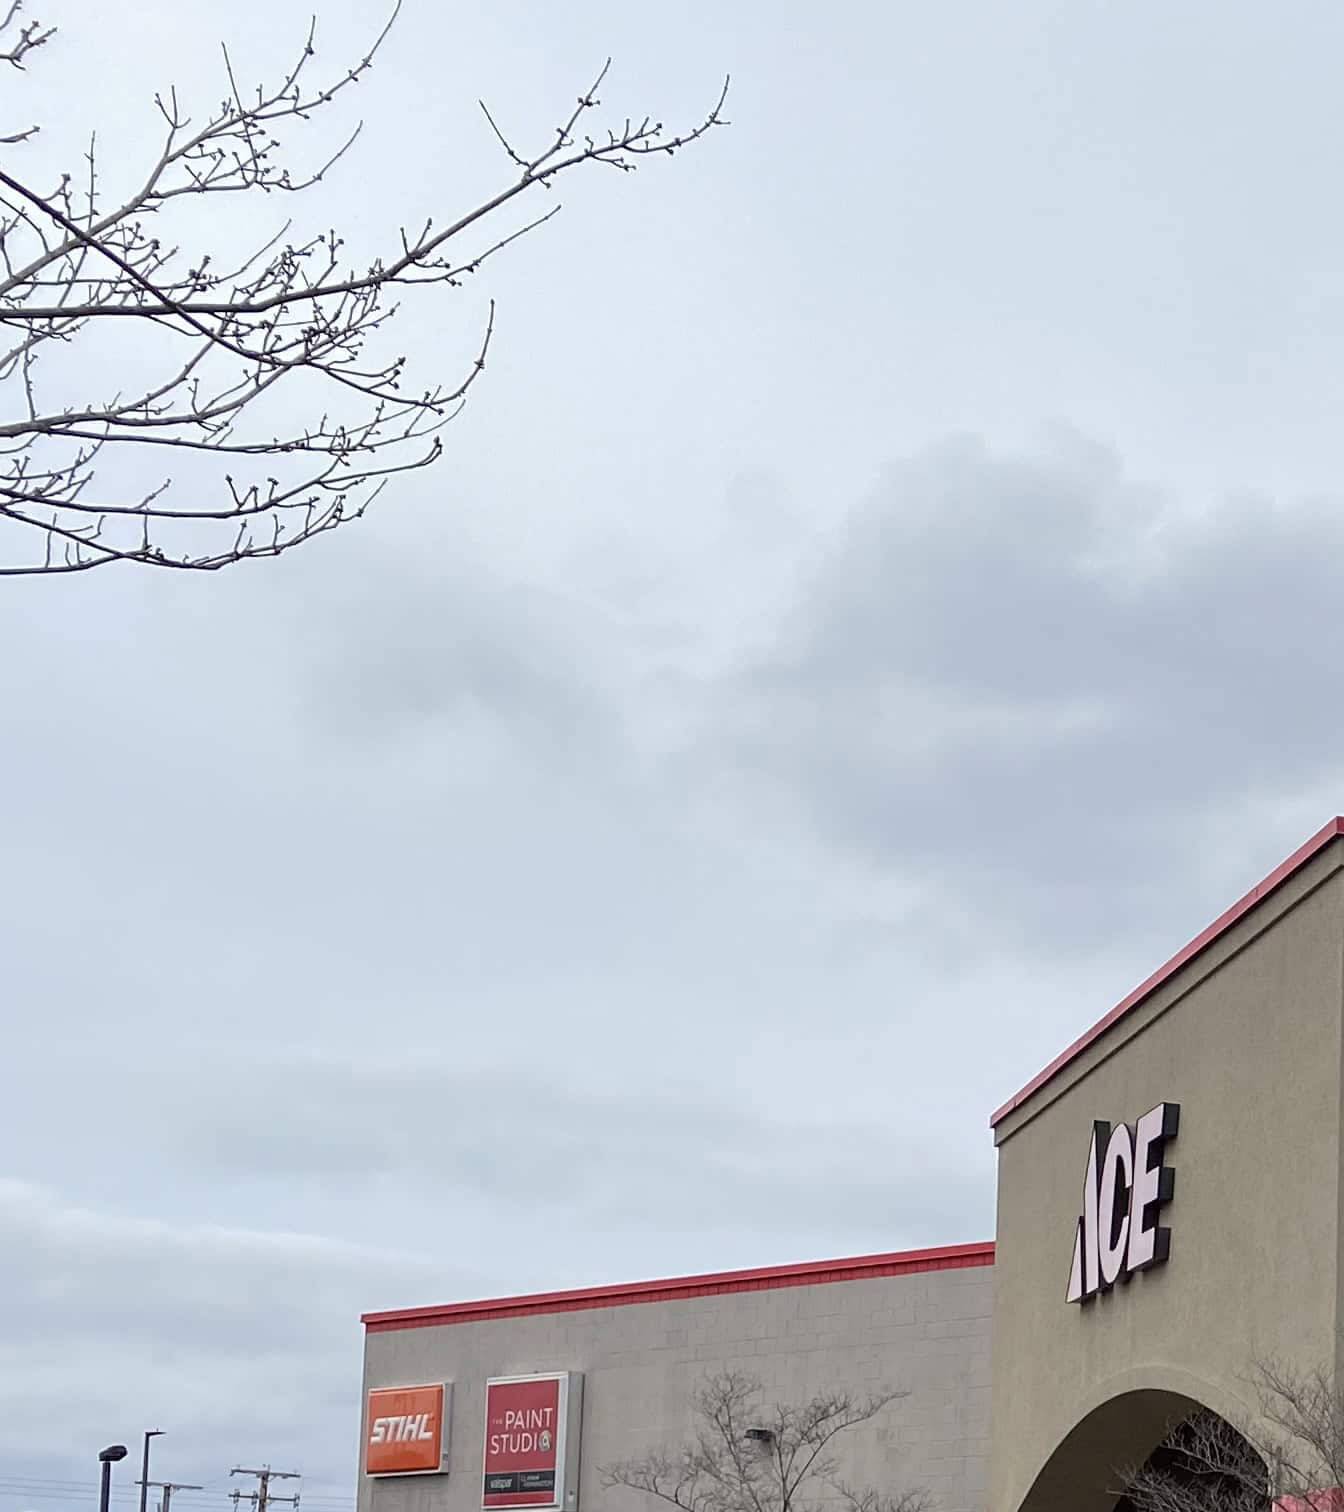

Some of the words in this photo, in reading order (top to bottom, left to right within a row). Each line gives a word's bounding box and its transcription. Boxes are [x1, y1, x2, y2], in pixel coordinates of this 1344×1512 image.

[1066, 1103, 1174, 1303] ACE
[370, 1413, 434, 1444] STIHL
[505, 1407, 553, 1430] PAINT
